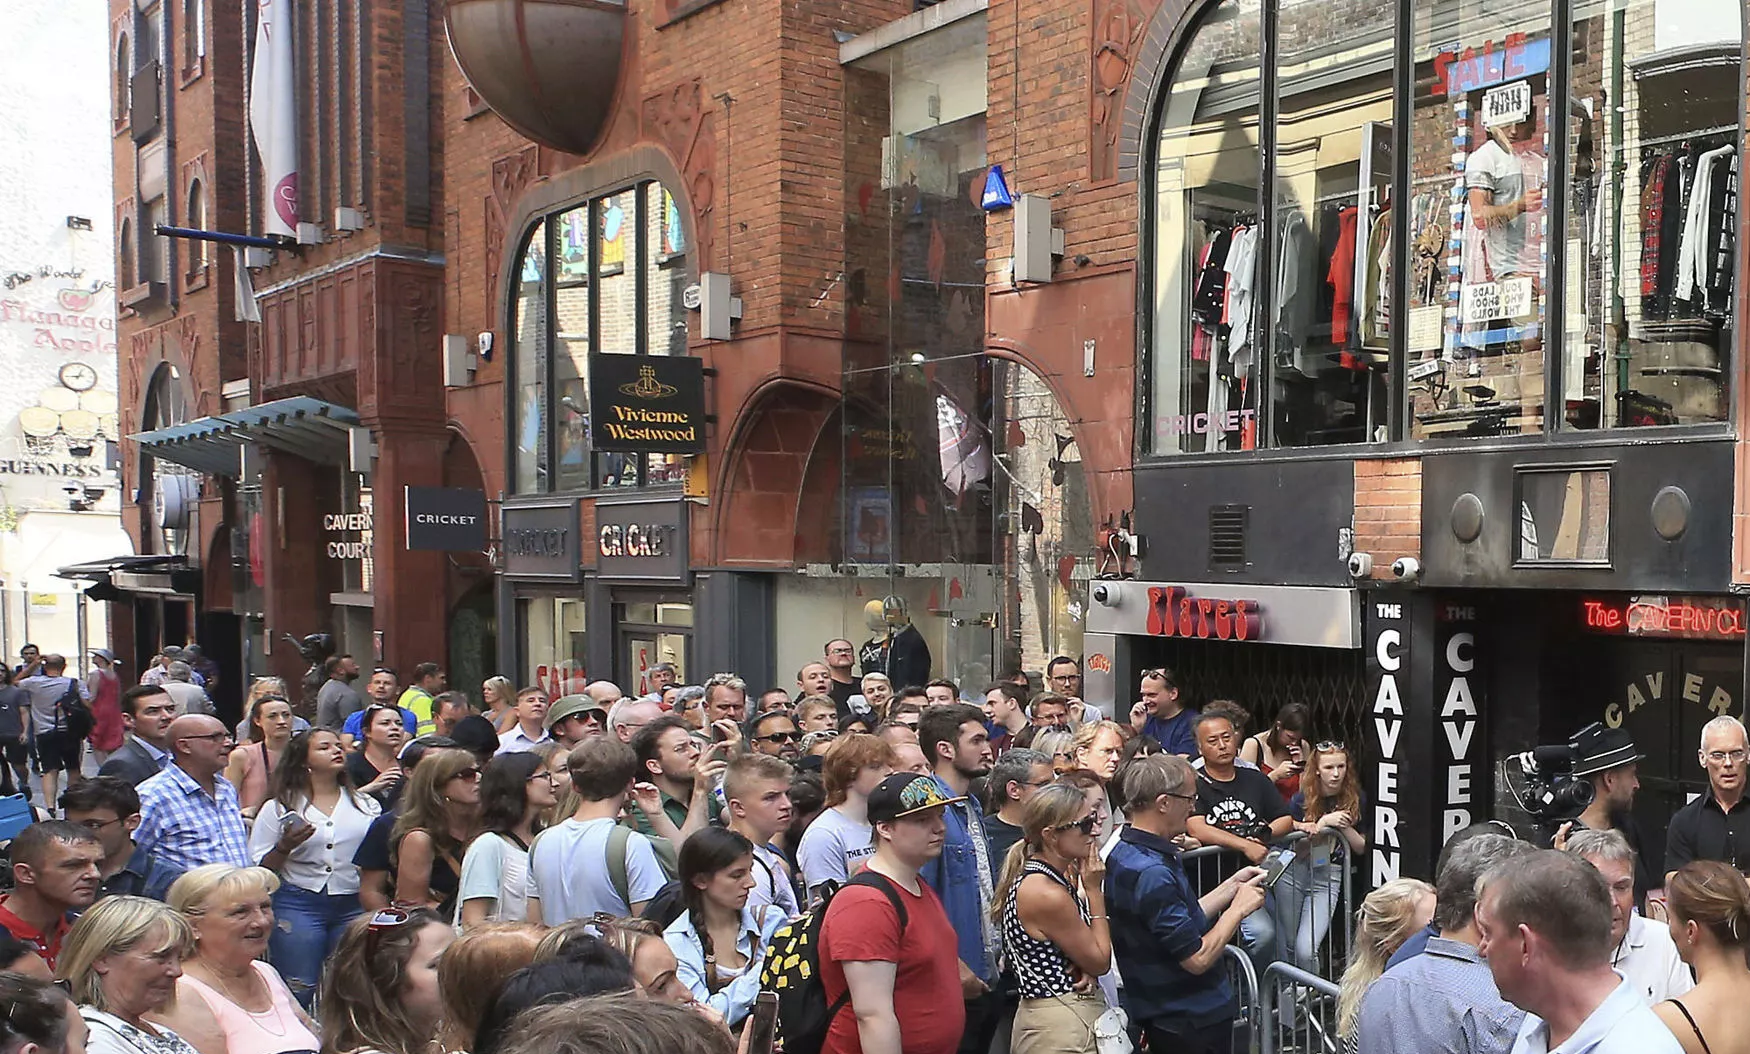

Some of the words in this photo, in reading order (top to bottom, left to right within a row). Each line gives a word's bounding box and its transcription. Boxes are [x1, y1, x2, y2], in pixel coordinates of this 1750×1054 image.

[1431, 32, 1527, 96] SALE
[611, 405, 688, 423] Vivienne
[1156, 409, 1254, 436] CRICKET
[605, 423, 696, 441] Westwood
[0, 459, 101, 477] GUINNESS
[324, 513, 373, 530] CAVERN
[416, 514, 476, 525] CRICKET
[600, 524, 676, 556] CRICKET
[1376, 604, 1402, 619] THE
[1446, 606, 1475, 620] THE
[1585, 602, 1621, 628] The
[1627, 604, 1715, 632] CAVERN
[1605, 672, 1744, 729] CAVER
[1373, 629, 1404, 888] CAVERN
[847, 848, 863, 859] THE
